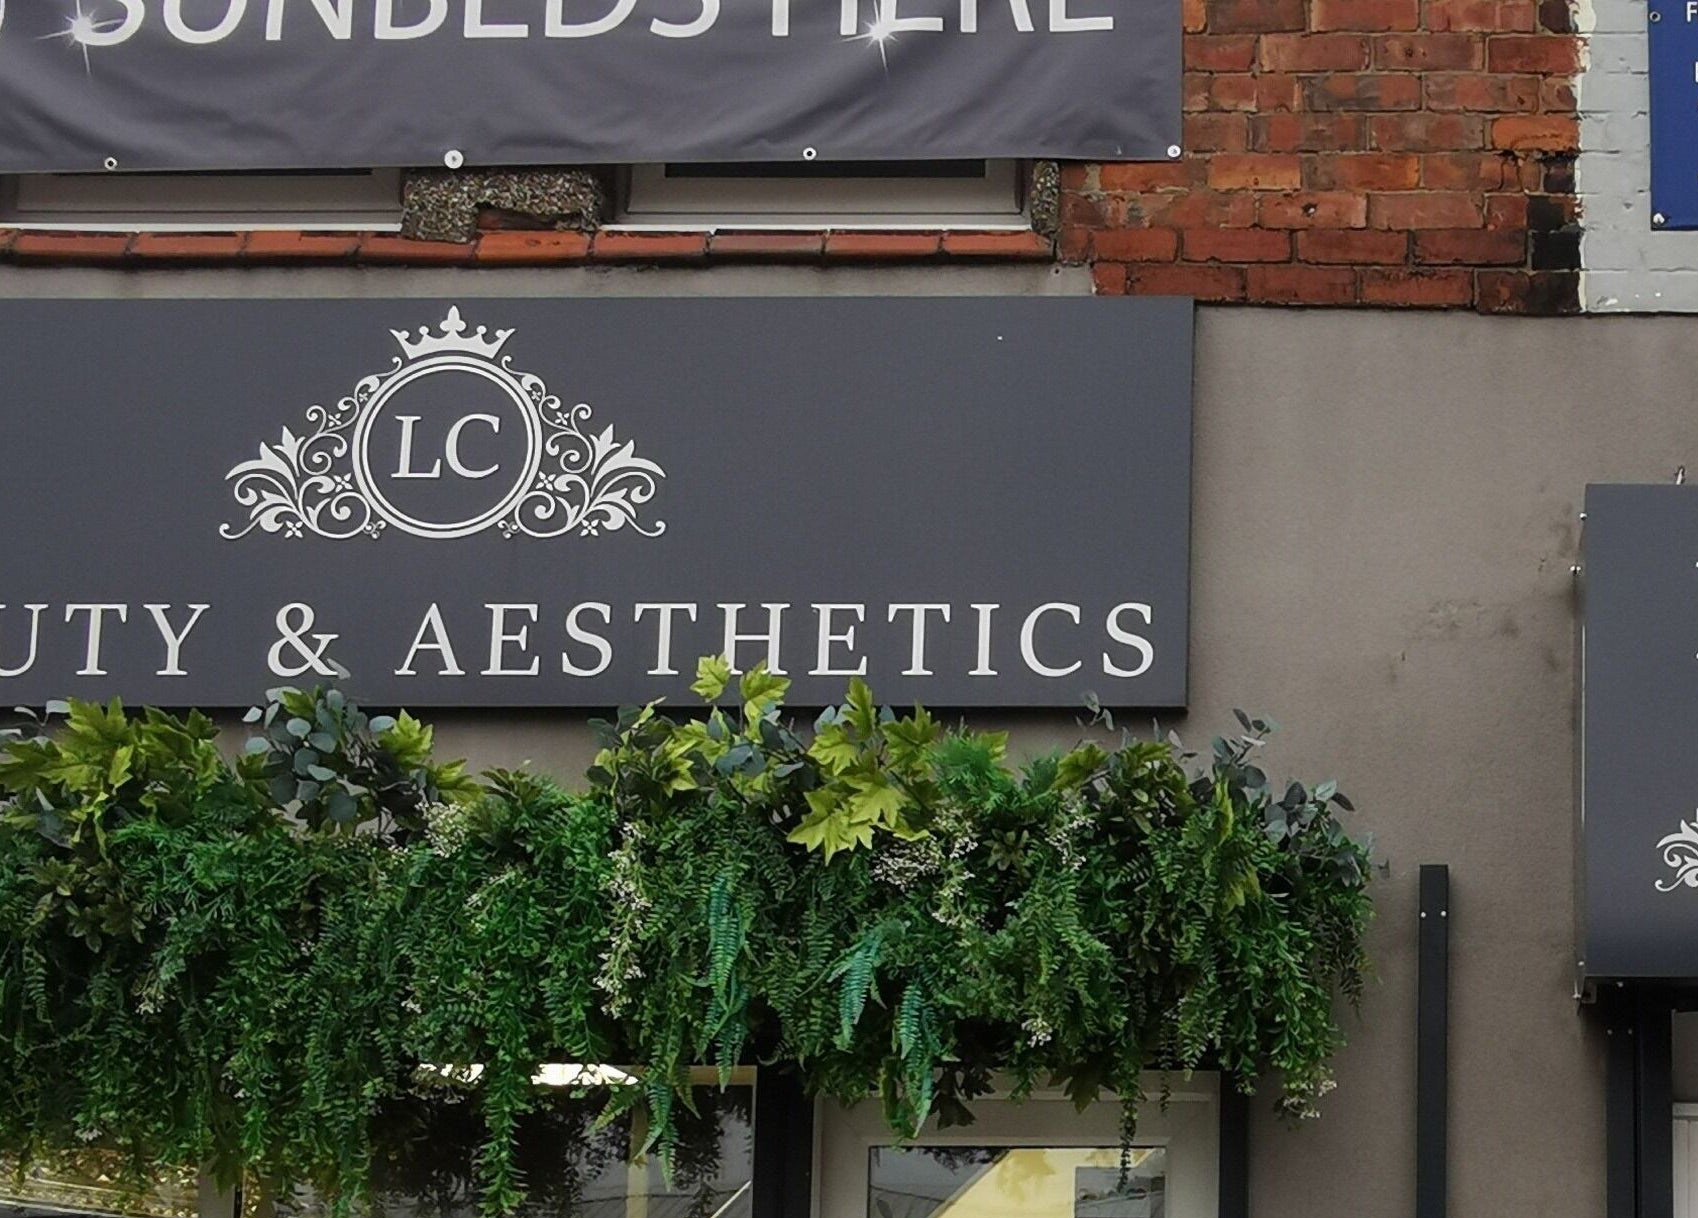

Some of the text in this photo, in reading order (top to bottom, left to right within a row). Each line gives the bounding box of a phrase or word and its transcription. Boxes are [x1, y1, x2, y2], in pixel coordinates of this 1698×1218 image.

[391, 414, 499, 478] LC
[264, 598, 342, 680] &
[395, 602, 1154, 677] AESTHETICS
